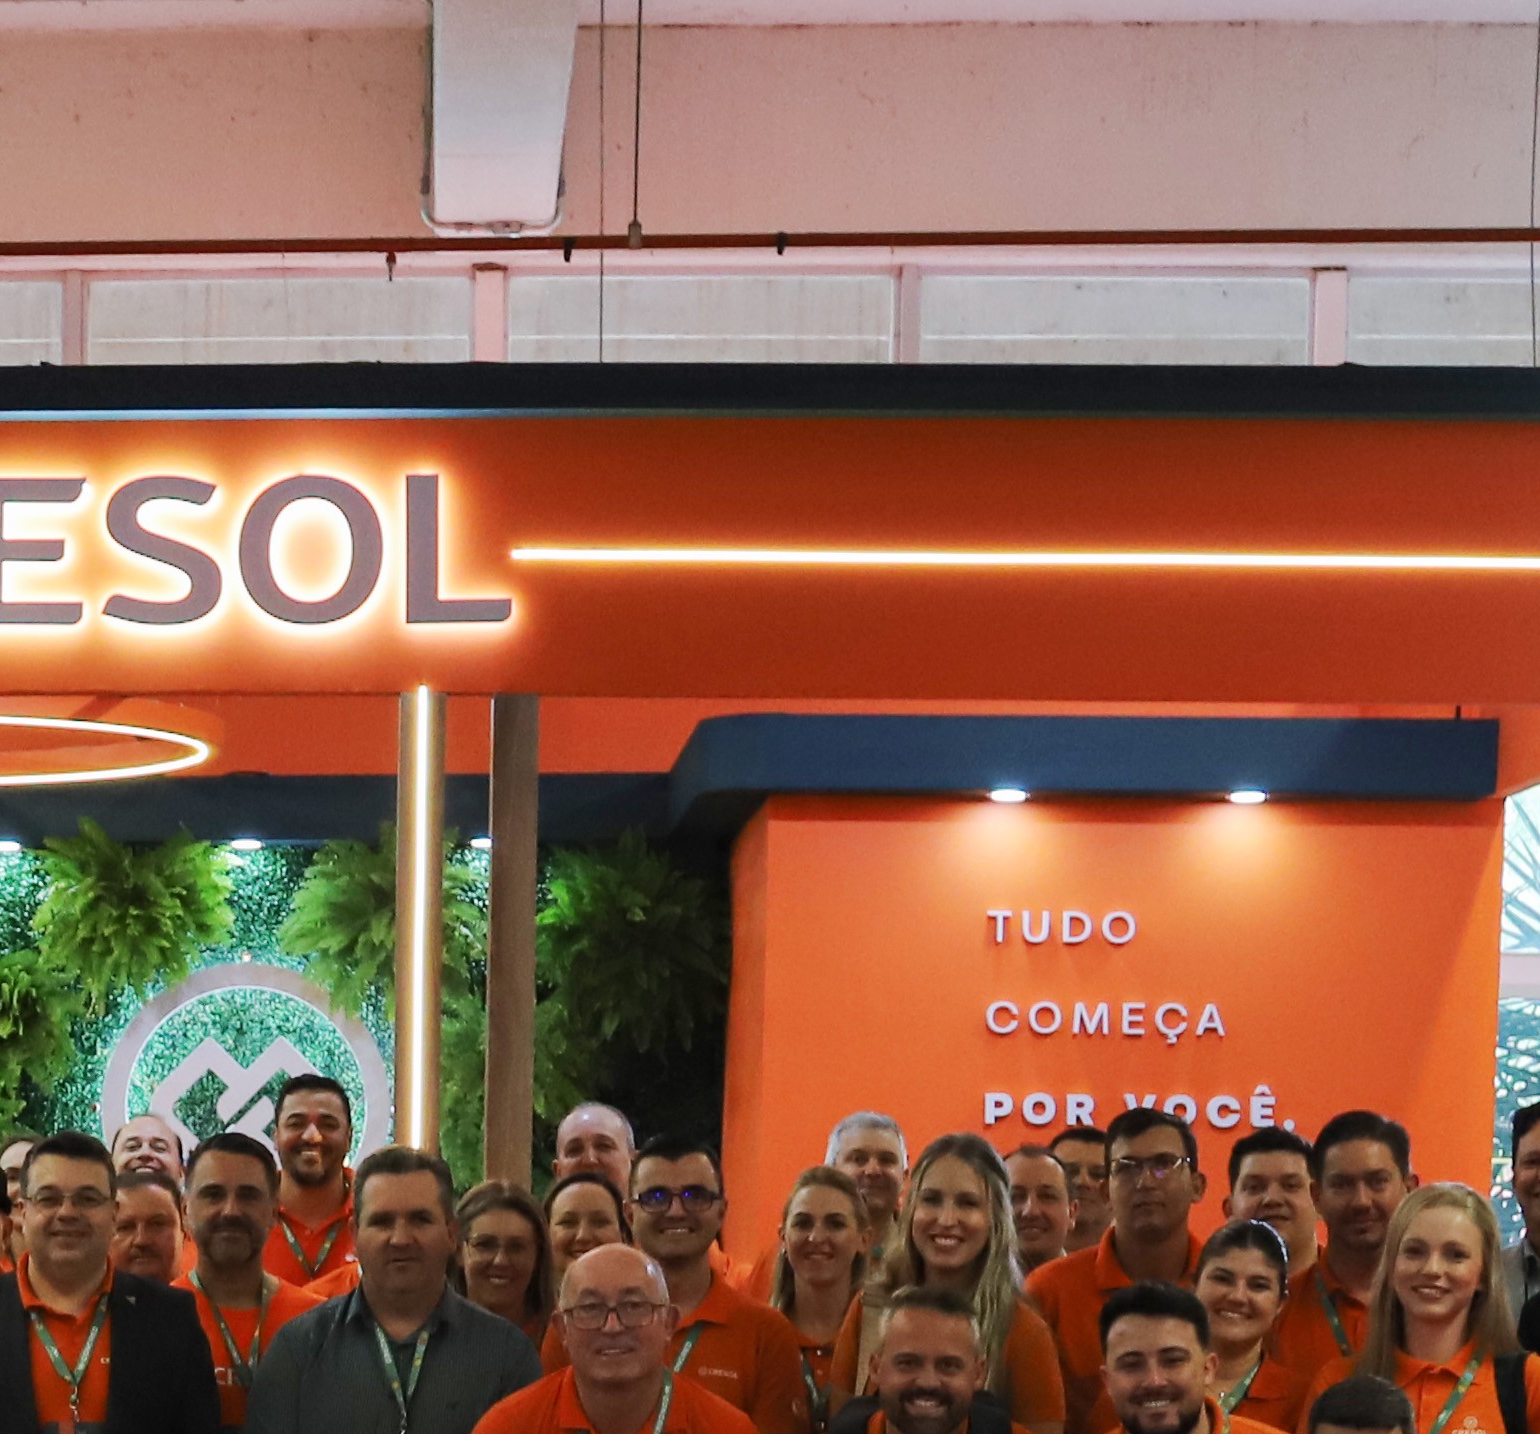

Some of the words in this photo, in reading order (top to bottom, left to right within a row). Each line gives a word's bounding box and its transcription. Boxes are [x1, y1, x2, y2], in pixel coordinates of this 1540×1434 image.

[986, 908, 1139, 944] TUDO
[984, 1000, 1226, 1046] COMEÇA
[982, 1092, 1096, 1127] POR
